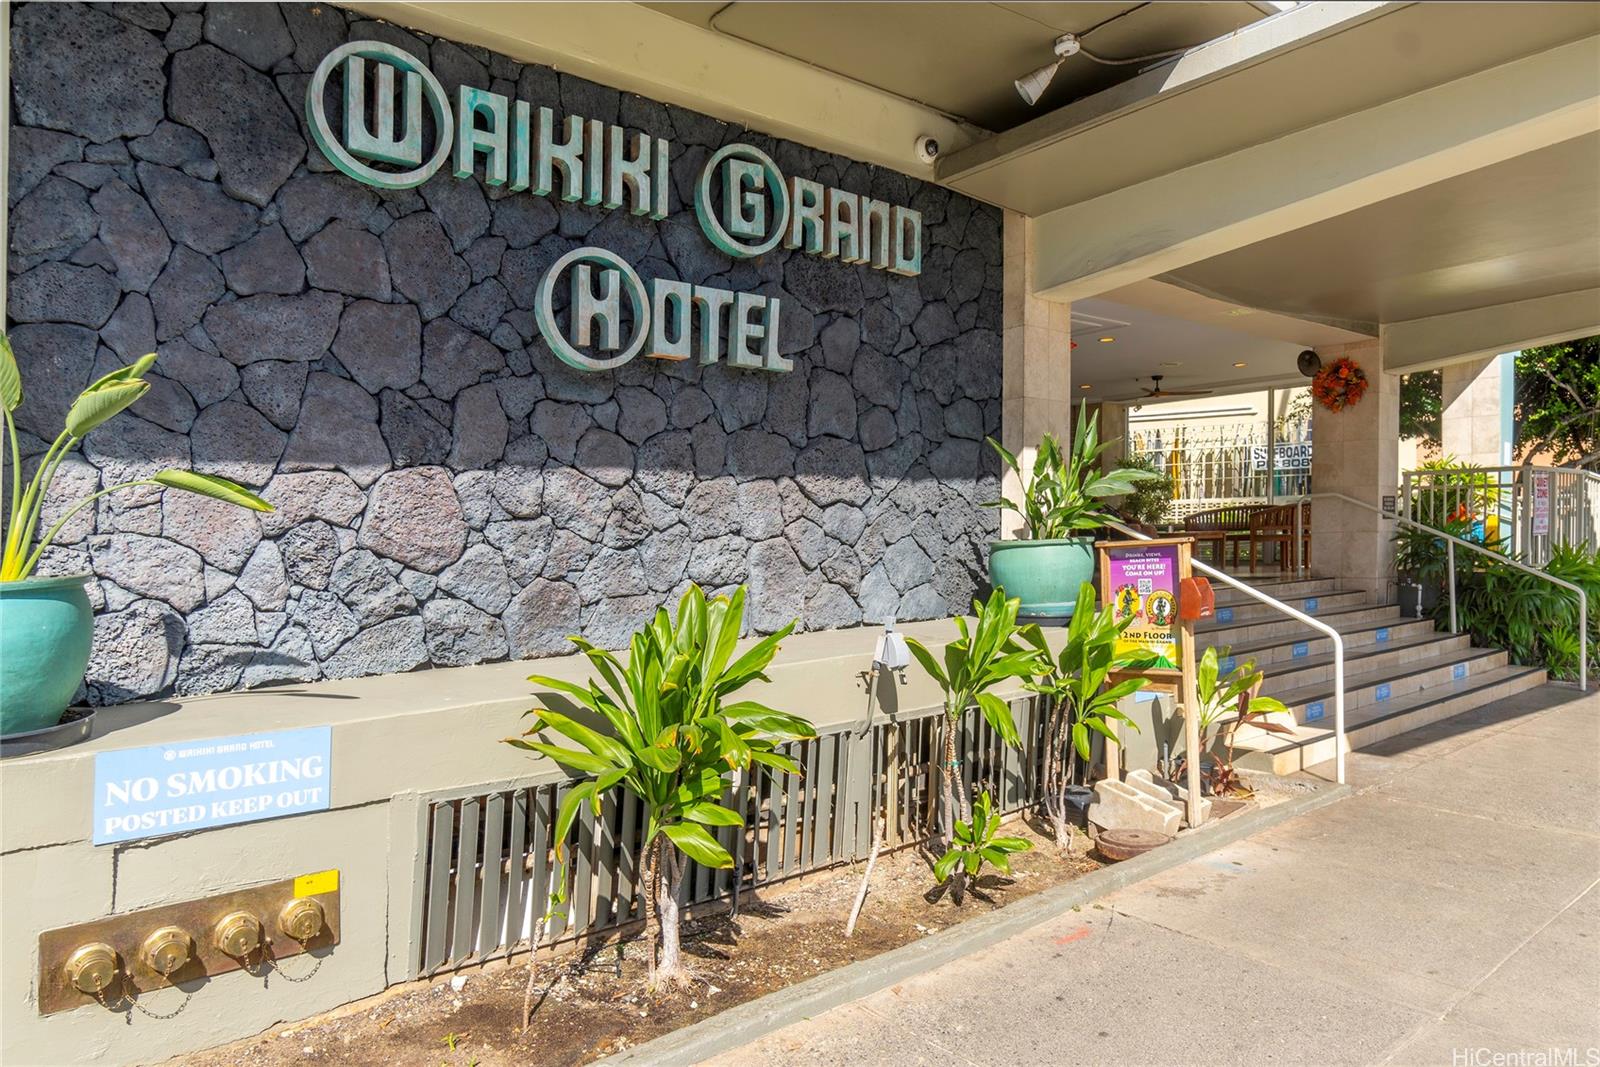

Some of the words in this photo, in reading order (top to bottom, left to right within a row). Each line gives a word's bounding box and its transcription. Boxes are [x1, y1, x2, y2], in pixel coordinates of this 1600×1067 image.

[344, 54, 669, 221] WAIKIKI
[722, 158, 923, 277] GRAND
[570, 263, 794, 373] HOTEL
[1123, 631, 1141, 639] 2ND
[1144, 631, 1172, 640] FLOOR
[104, 776, 159, 807] NO
[167, 755, 324, 798] SMOKING
[104, 804, 207, 836] POSTED
[211, 794, 273, 819] KEEP
[276, 787, 323, 809] OUT
